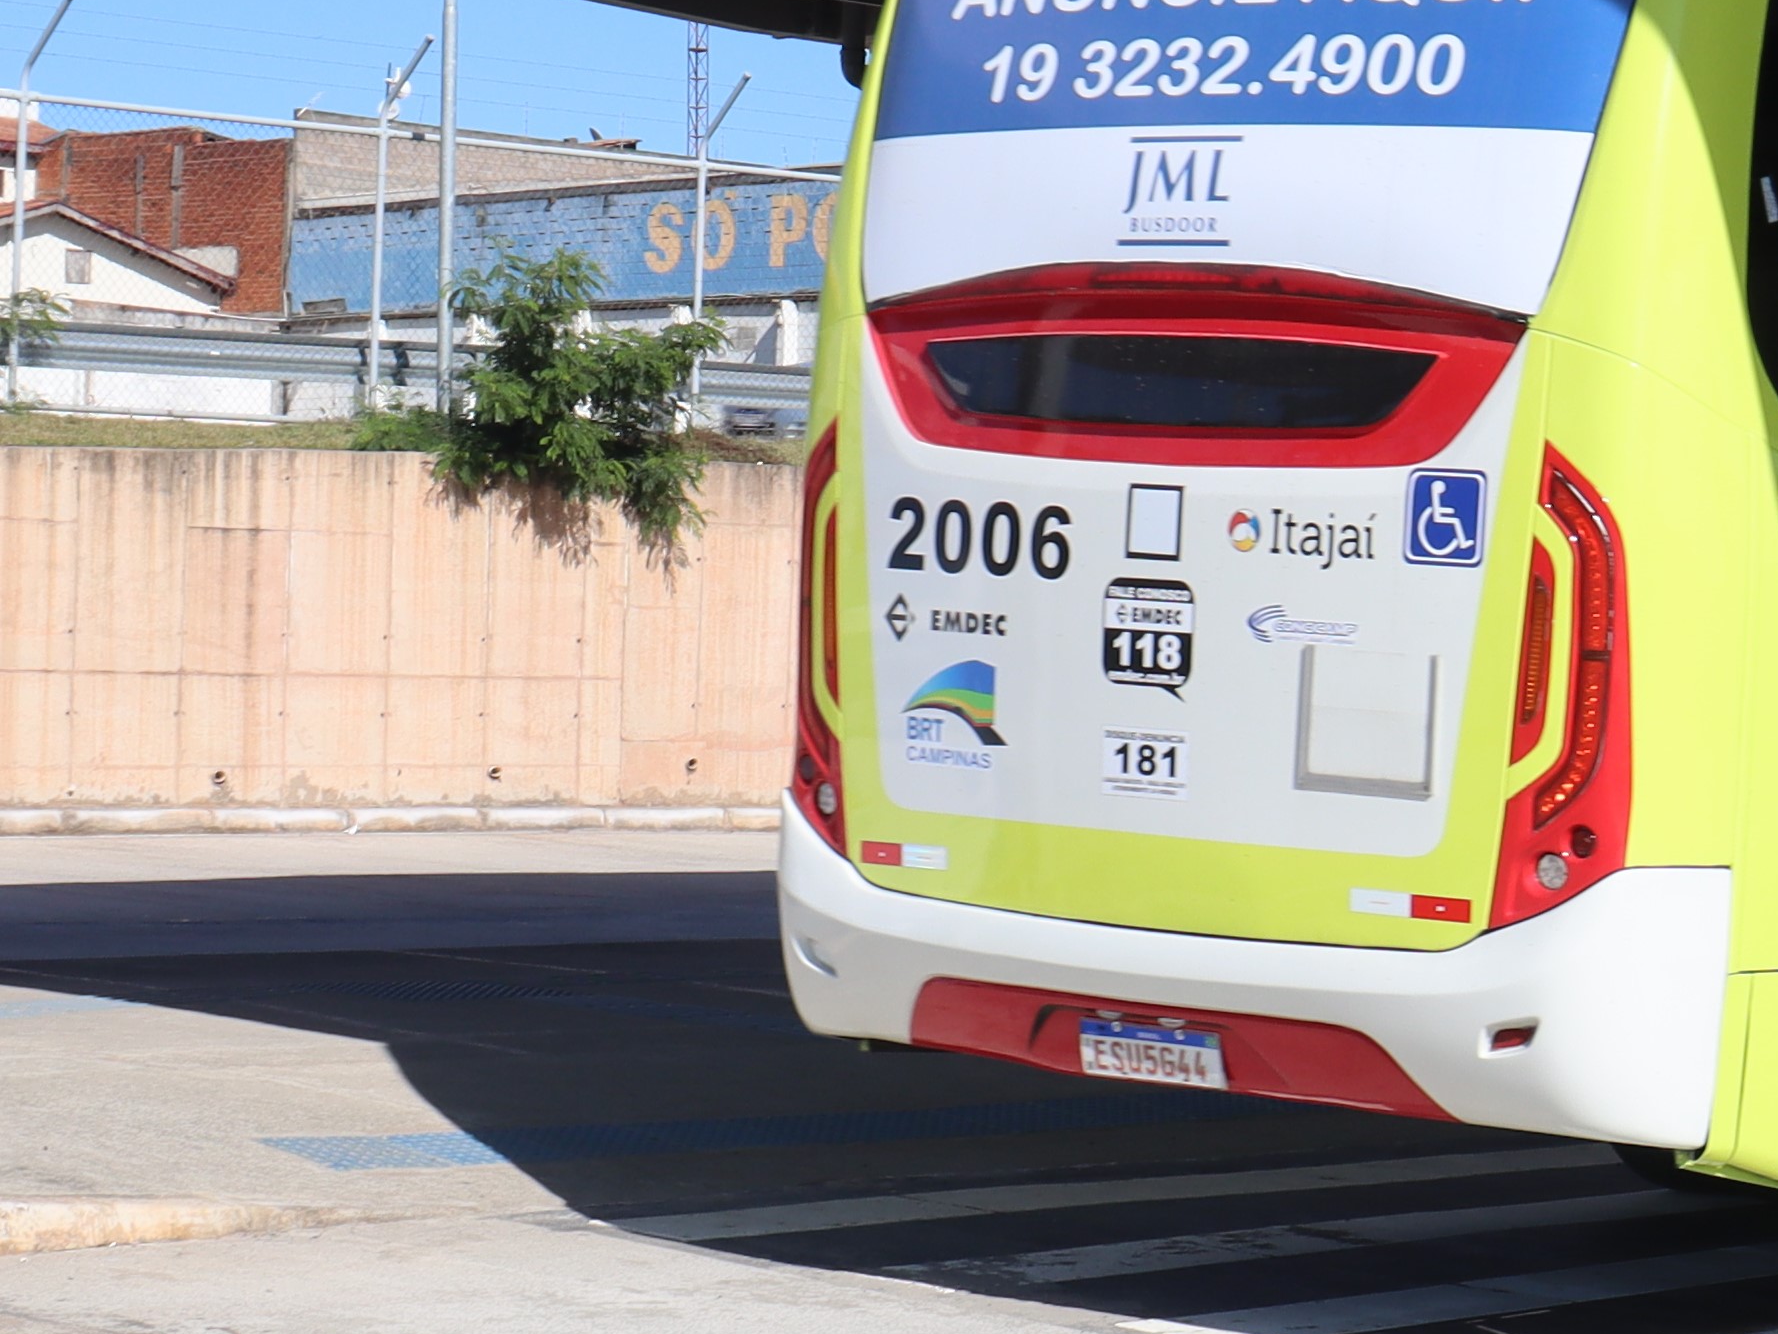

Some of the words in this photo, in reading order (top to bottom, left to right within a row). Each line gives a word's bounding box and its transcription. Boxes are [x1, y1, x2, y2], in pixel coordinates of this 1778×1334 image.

[981, 41, 1059, 104] 19
[1072, 33, 1466, 99] 3232.4900
[1122, 148, 1231, 215] JML
[644, 190, 736, 274] SÓ
[1129, 216, 1218, 235] BUSDOOR
[885, 495, 1072, 579] 2006
[1268, 508, 1376, 571] Itajaí
[930, 608, 1008, 638] EMDEC
[1132, 607, 1182, 625] EMDEC
[1112, 631, 1182, 670] 118
[906, 716, 944, 744] BRT
[905, 747, 992, 770] CAMPINAS
[1114, 743, 1178, 777] 181
